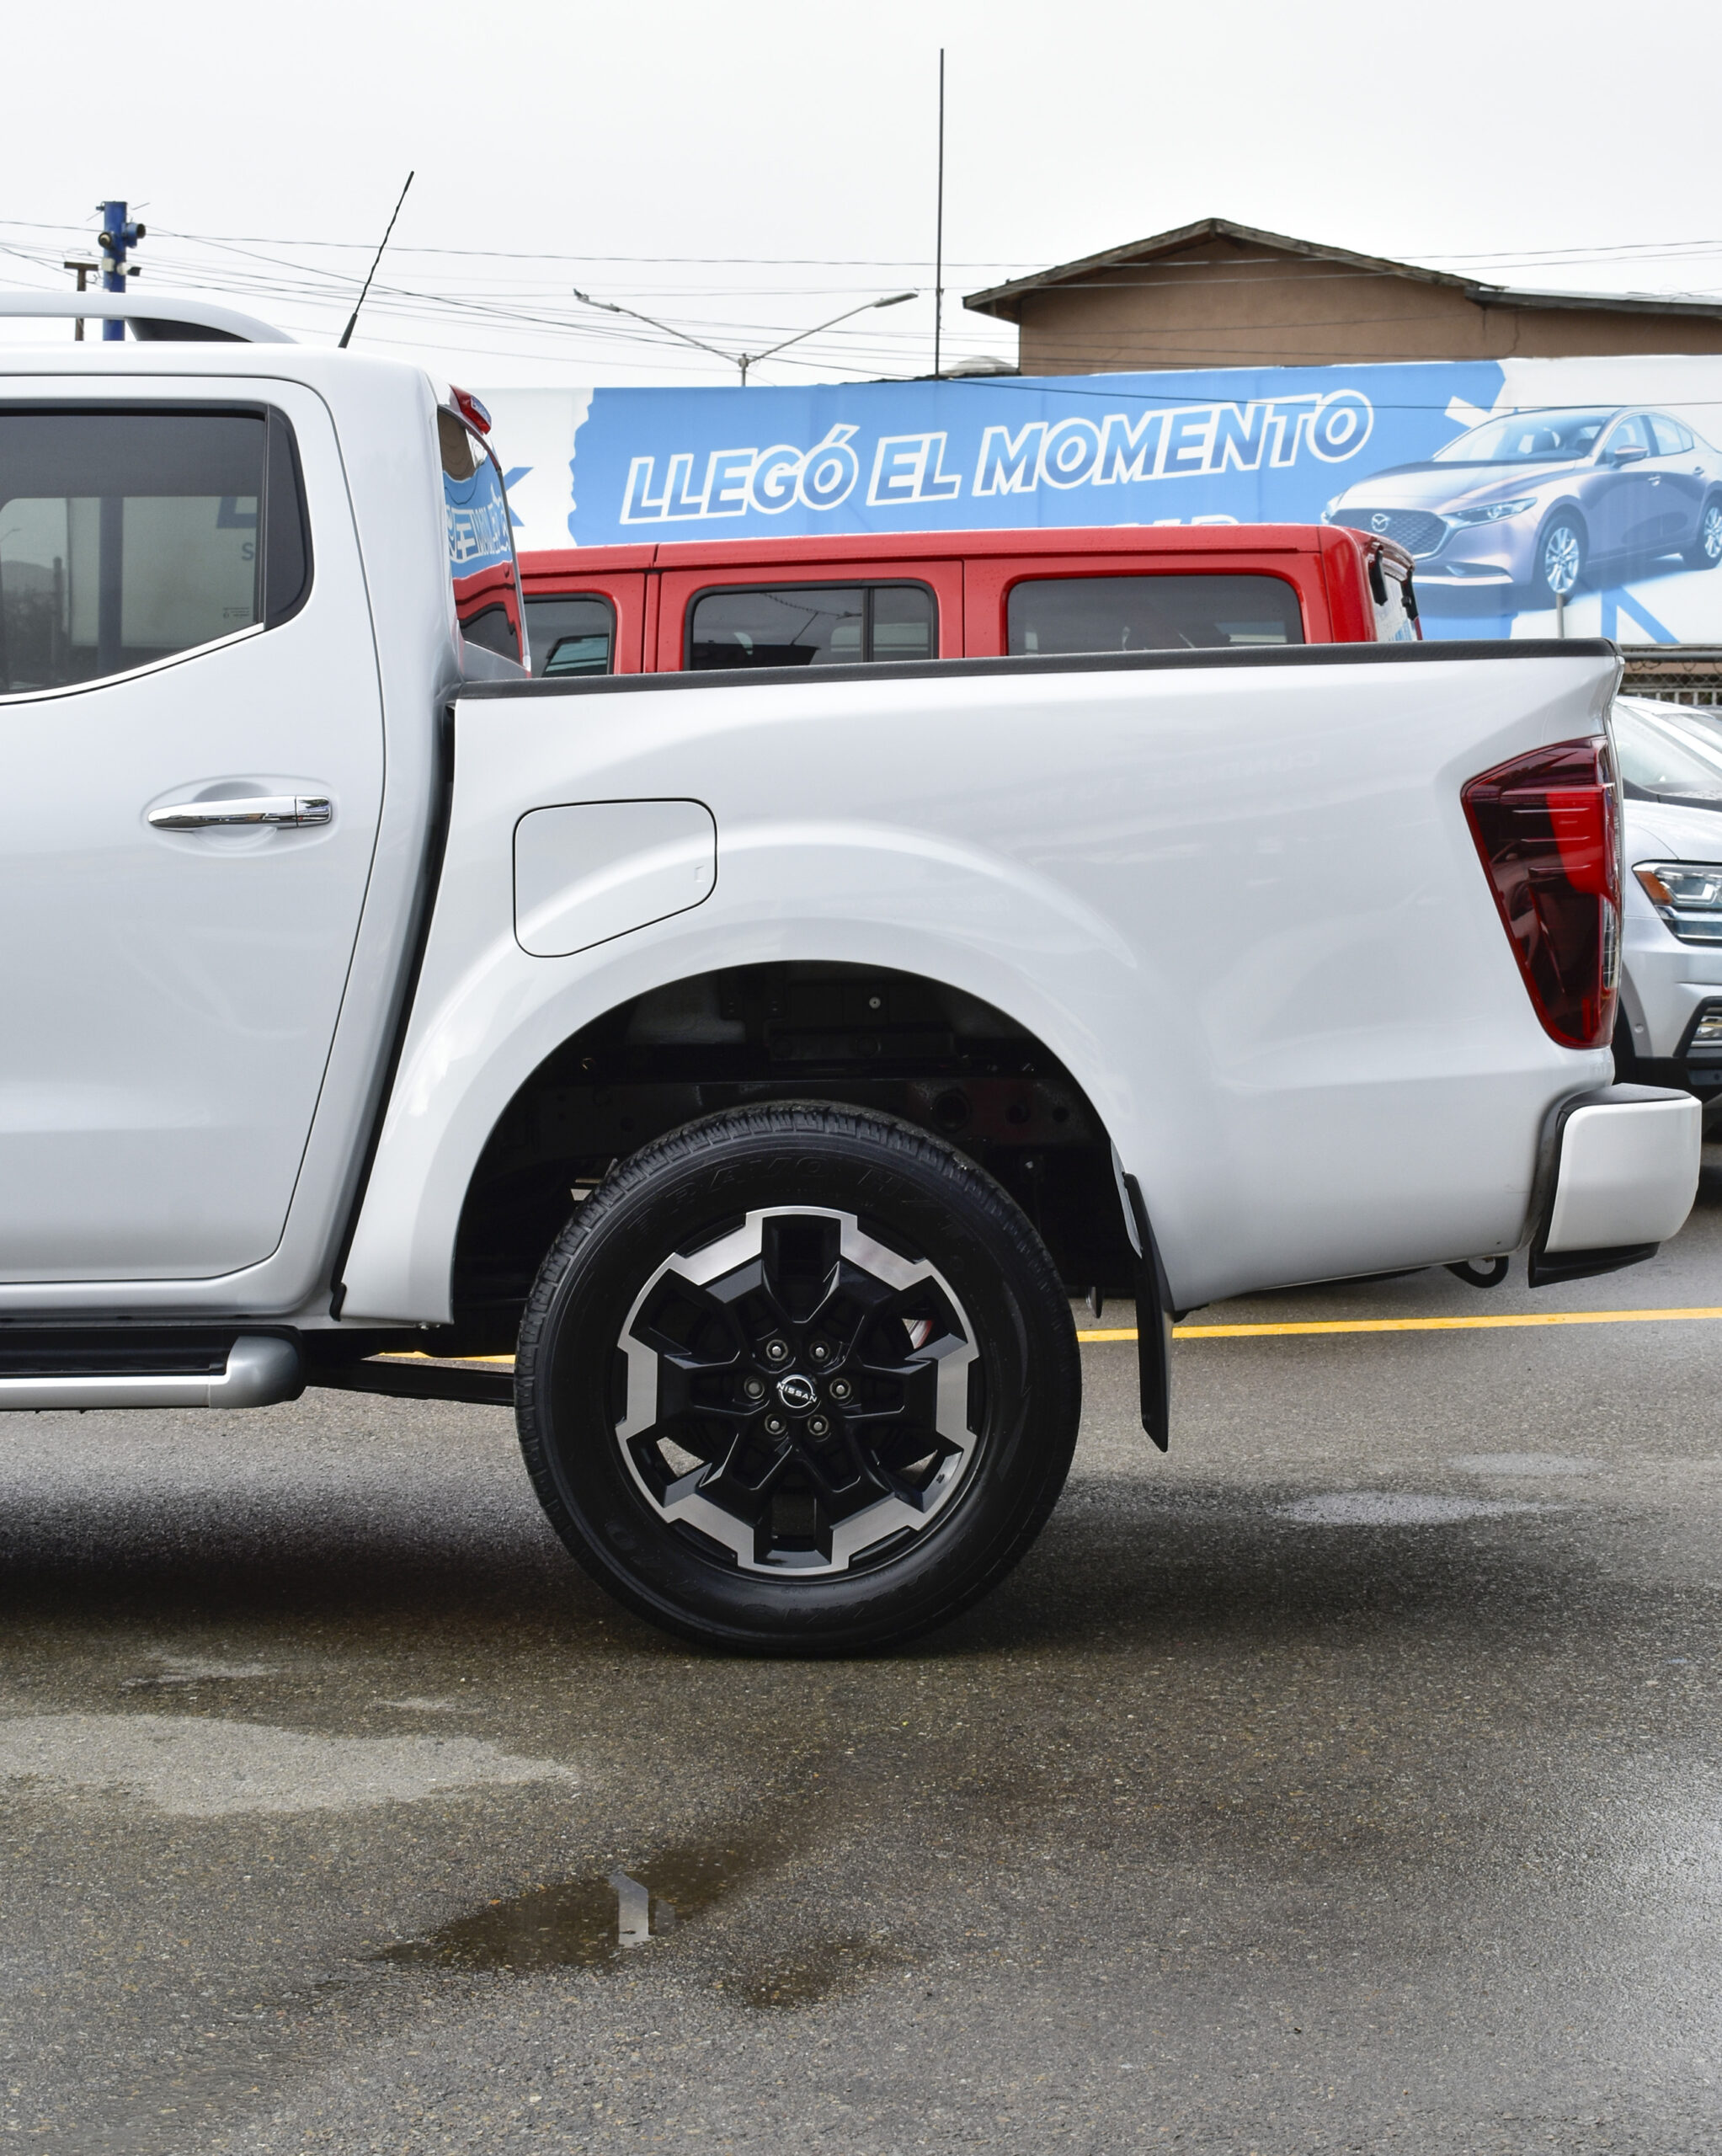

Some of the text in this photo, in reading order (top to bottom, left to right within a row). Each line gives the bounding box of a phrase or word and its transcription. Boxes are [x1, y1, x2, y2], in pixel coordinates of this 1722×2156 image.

[620, 423, 861, 525] LLEGÓ
[866, 431, 962, 506] EL
[972, 388, 1374, 497] MOMENTO
[776, 1381, 817, 1402] NISSAN
